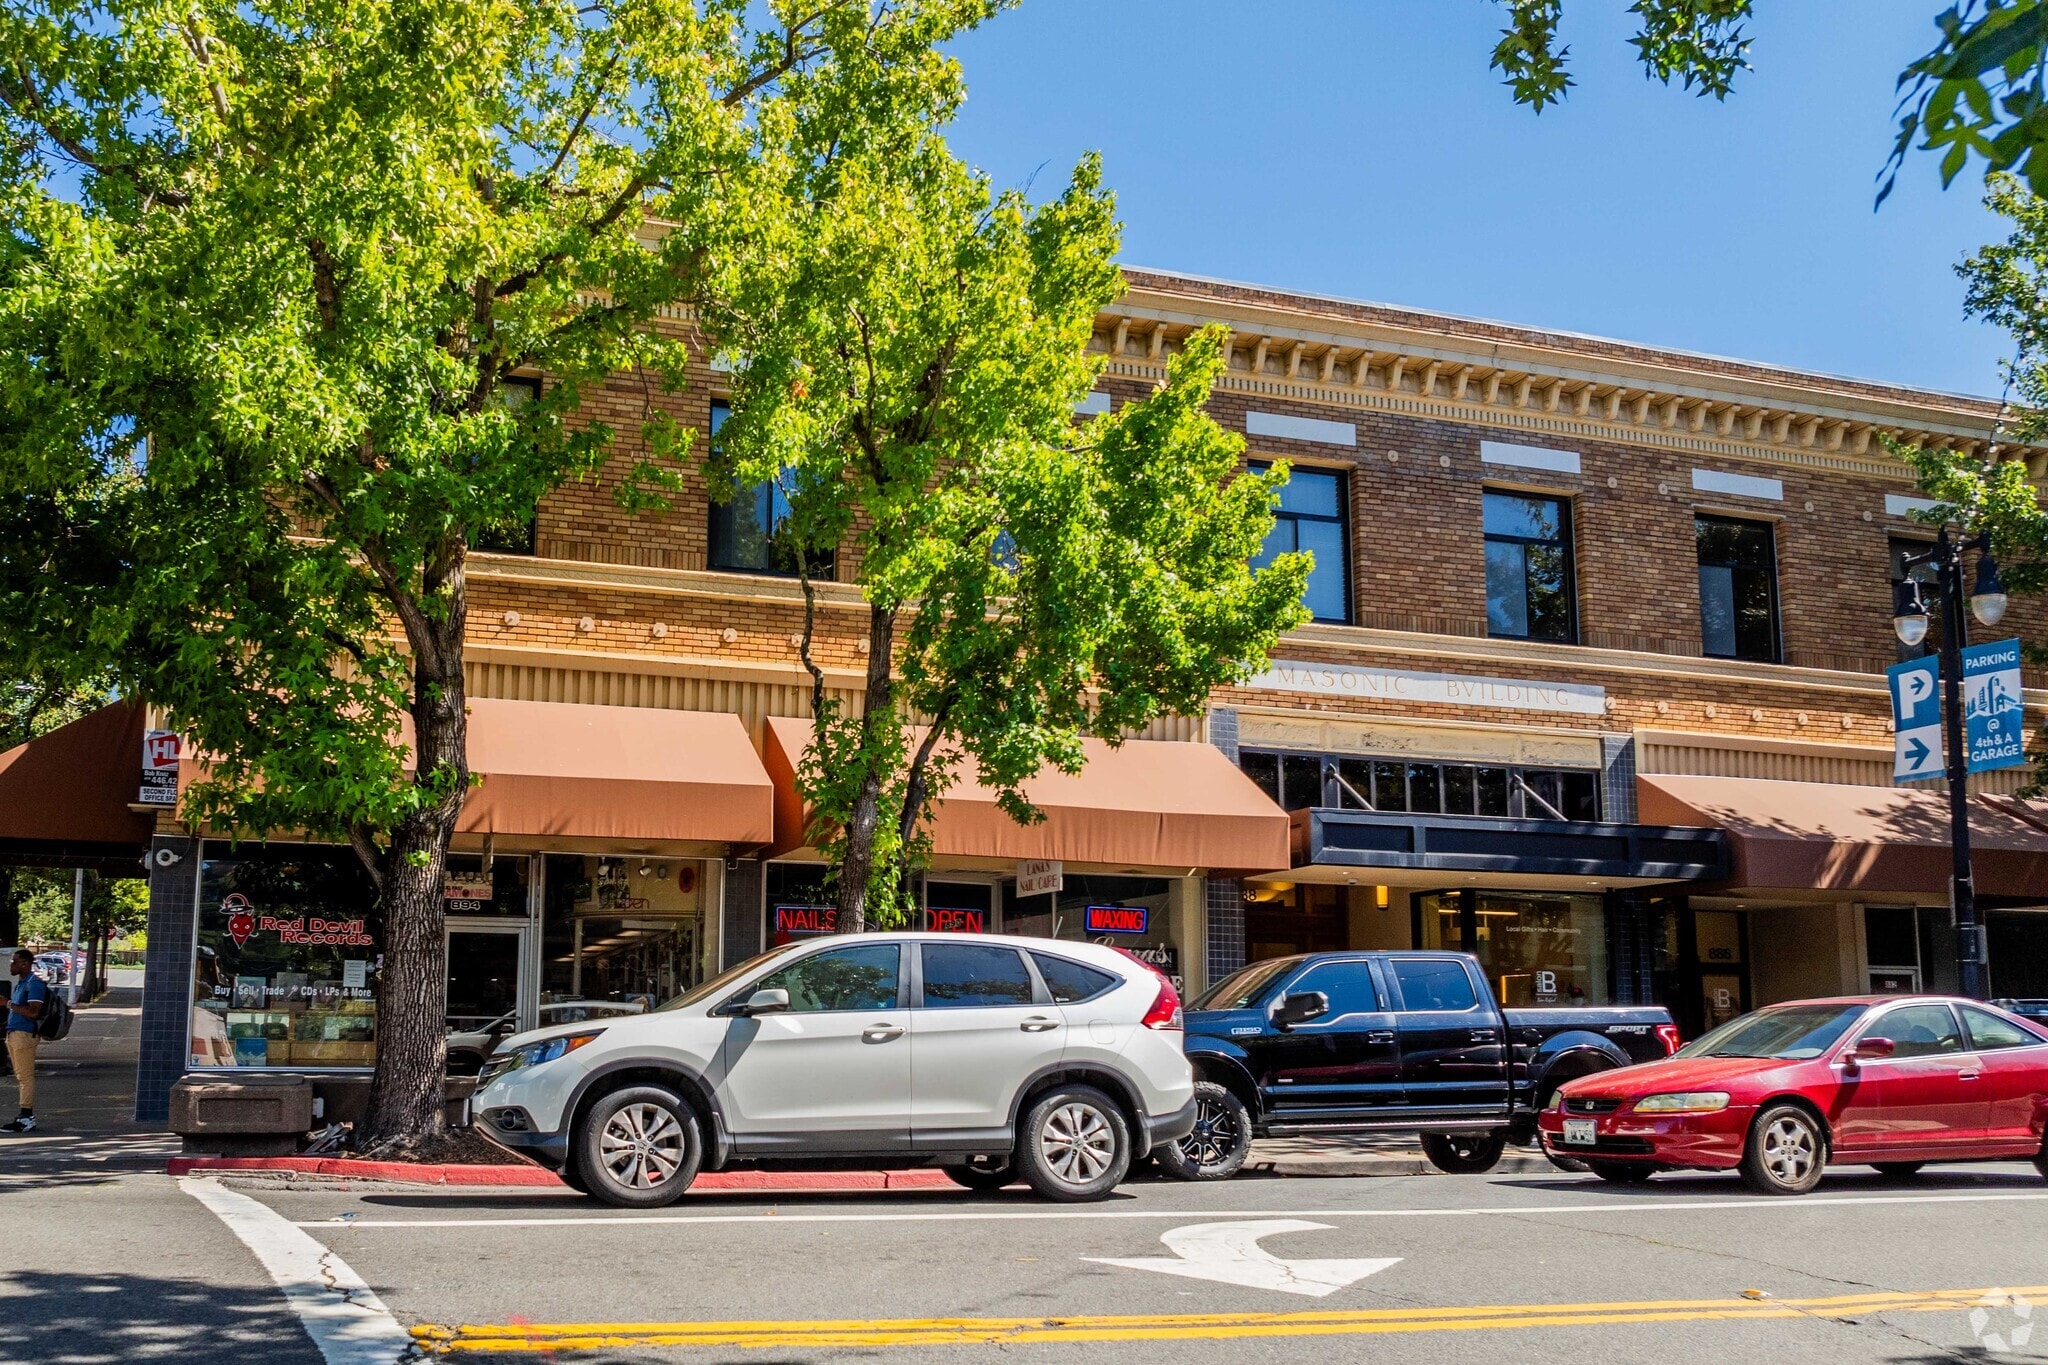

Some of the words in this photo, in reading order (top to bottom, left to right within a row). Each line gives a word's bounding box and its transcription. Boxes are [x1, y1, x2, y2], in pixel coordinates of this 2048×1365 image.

[1965, 651, 2016, 669] PARKING
[1277, 665, 1408, 694] MASONIC
[1446, 679, 1570, 706] BVILDING
[1898, 669, 1933, 720] P
[1987, 718, 2000, 733] @
[1975, 736, 1993, 748] 4th
[1995, 735, 2003, 745] &
[2004, 732, 2014, 743] A
[1971, 744, 2019, 762] GARAGE
[143, 787, 166, 795] SECOND
[1020, 878, 1036, 892] NAIL
[1038, 875, 1057, 889] CARE
[445, 889, 491, 898] AMONES
[450, 900, 480, 910] 894
[260, 917, 304, 931] Red
[309, 918, 364, 933] Devil
[779, 910, 837, 929] NAILS
[1090, 909, 1144, 930] WAXING
[280, 930, 373, 946] Records
[214, 985, 231, 997] Buy
[238, 985, 254, 995] Sell
[261, 985, 284, 995] Trade
[300, 986, 317, 996] CDs
[325, 986, 339, 996] LPs
[343, 987, 349, 996] &
[351, 987, 372, 997] More
[1605, 1025, 1651, 1034] SPORT
